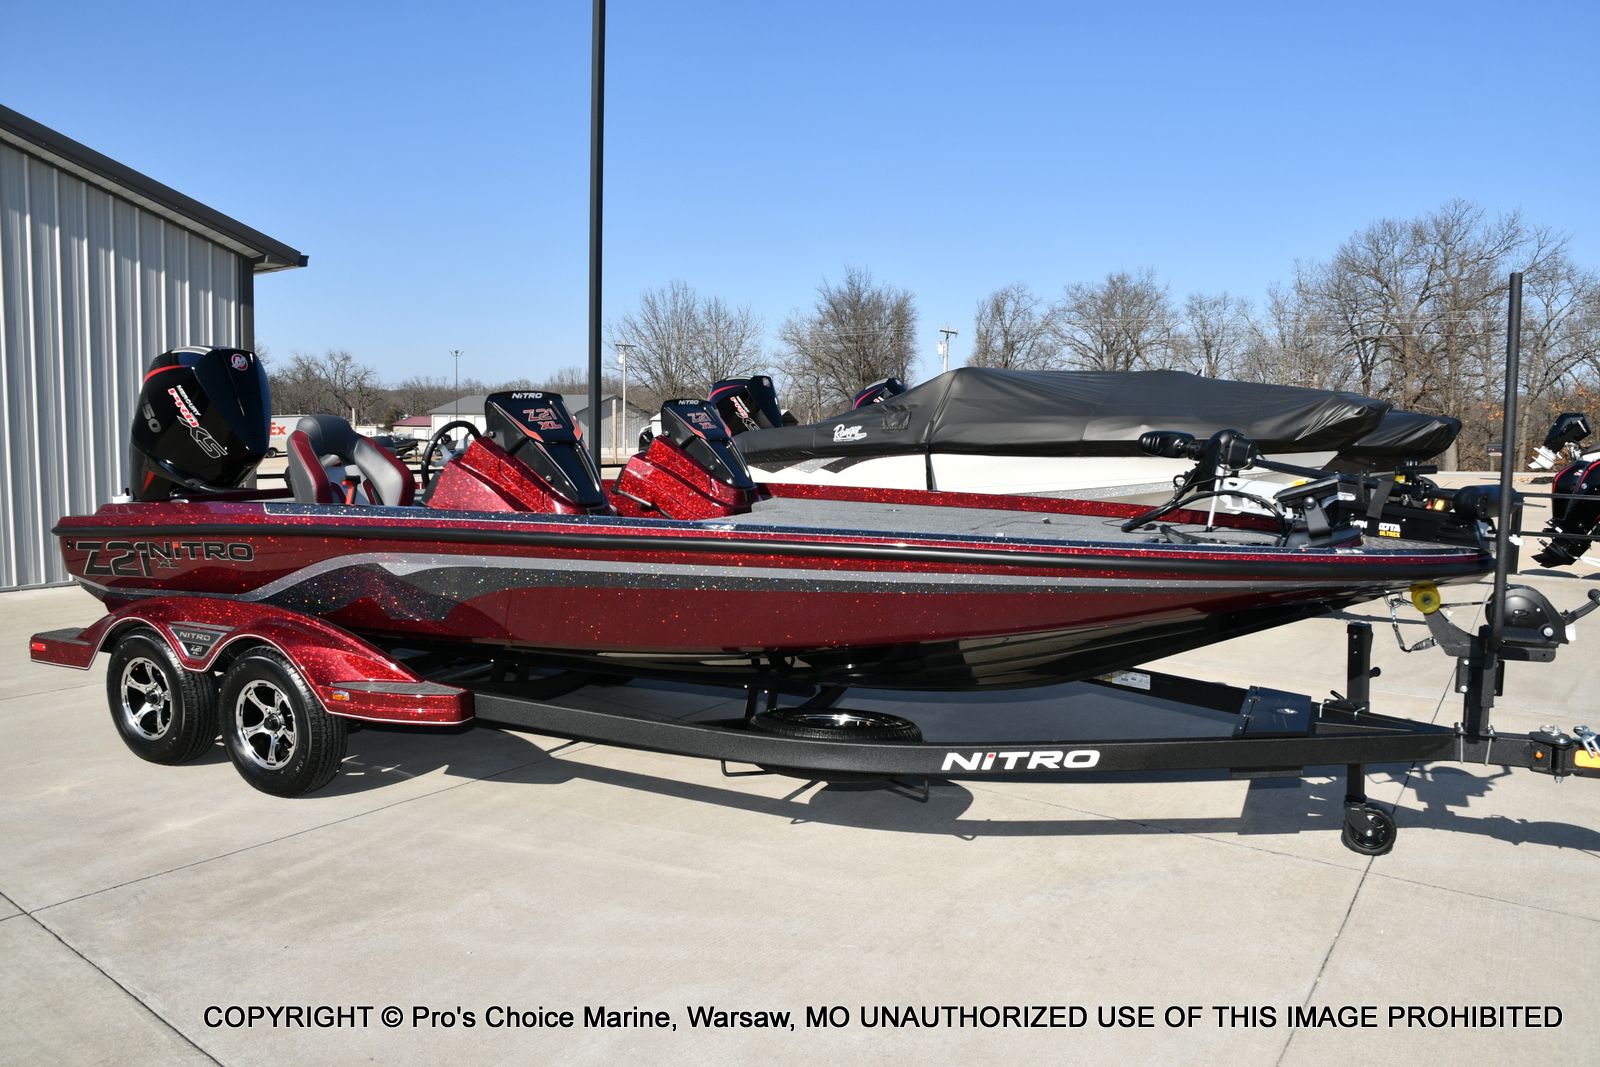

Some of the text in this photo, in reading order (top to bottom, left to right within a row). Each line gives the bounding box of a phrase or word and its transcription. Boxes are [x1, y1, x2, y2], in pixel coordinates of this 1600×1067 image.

[176, 384, 201, 416] MERCURY
[523, 407, 557, 421] Z21
[142, 400, 162, 433] 50
[76, 540, 154, 578] Z21
[179, 631, 211, 641] NITRO
